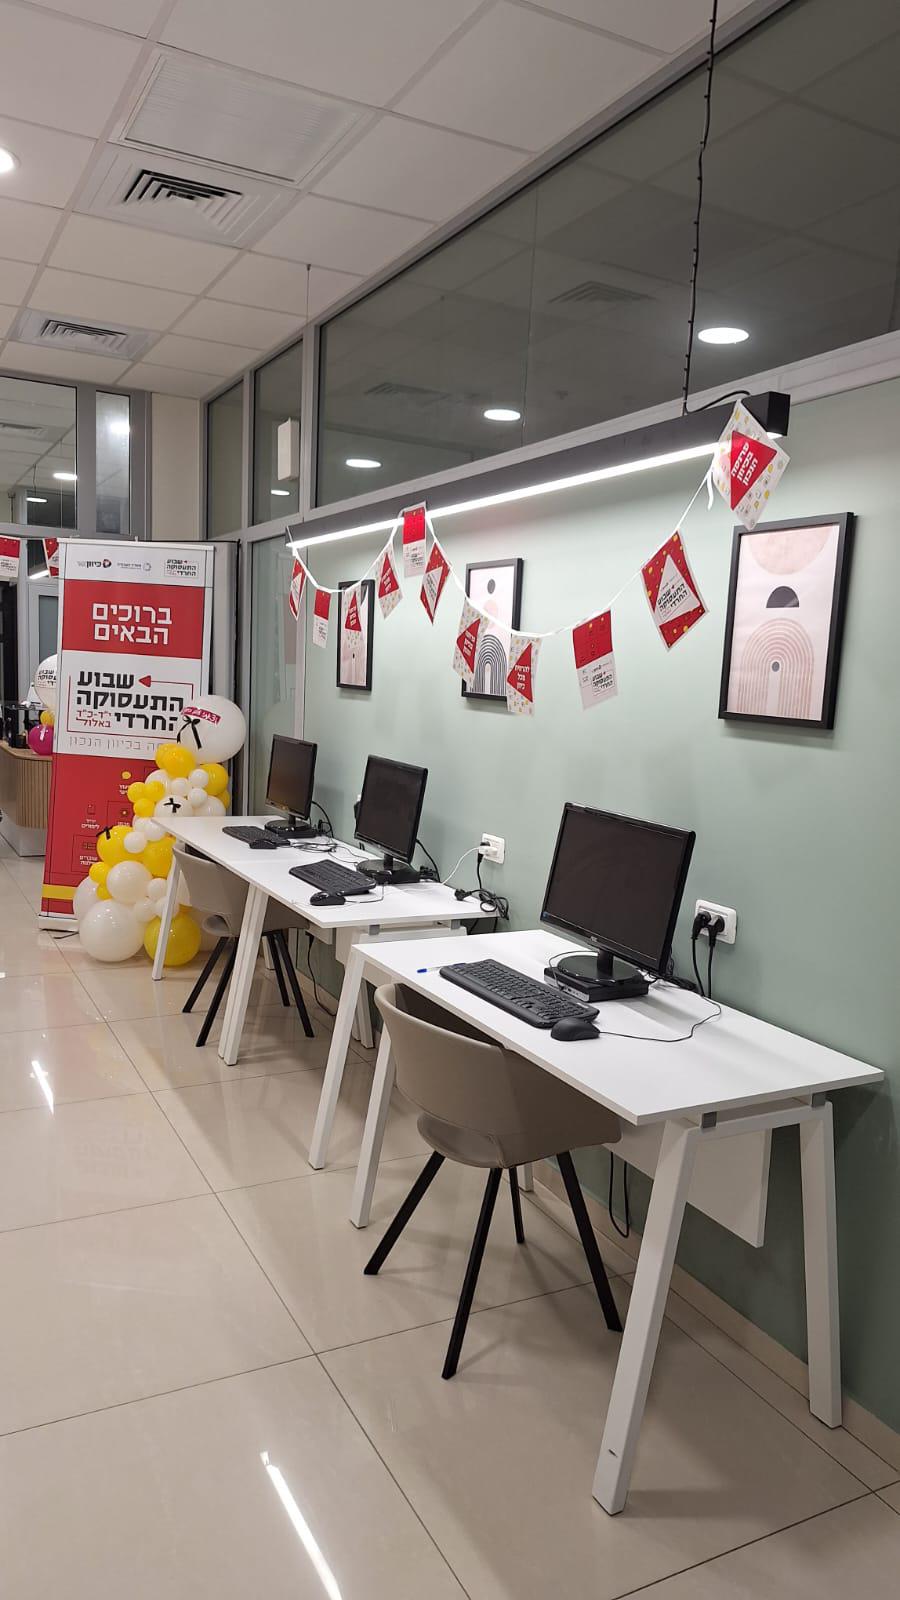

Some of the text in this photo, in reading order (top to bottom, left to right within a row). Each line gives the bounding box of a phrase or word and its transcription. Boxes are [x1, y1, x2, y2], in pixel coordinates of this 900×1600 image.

[92, 602, 172, 625] ברוכים
[94, 623, 168, 645] הבאים
[77, 670, 135, 689] שבוע
[76, 690, 184, 711] התעסוקה
[76, 717, 111, 728] באלול
[69, 736, 101, 748] הנכון
[107, 739, 141, 750] בכיוון
